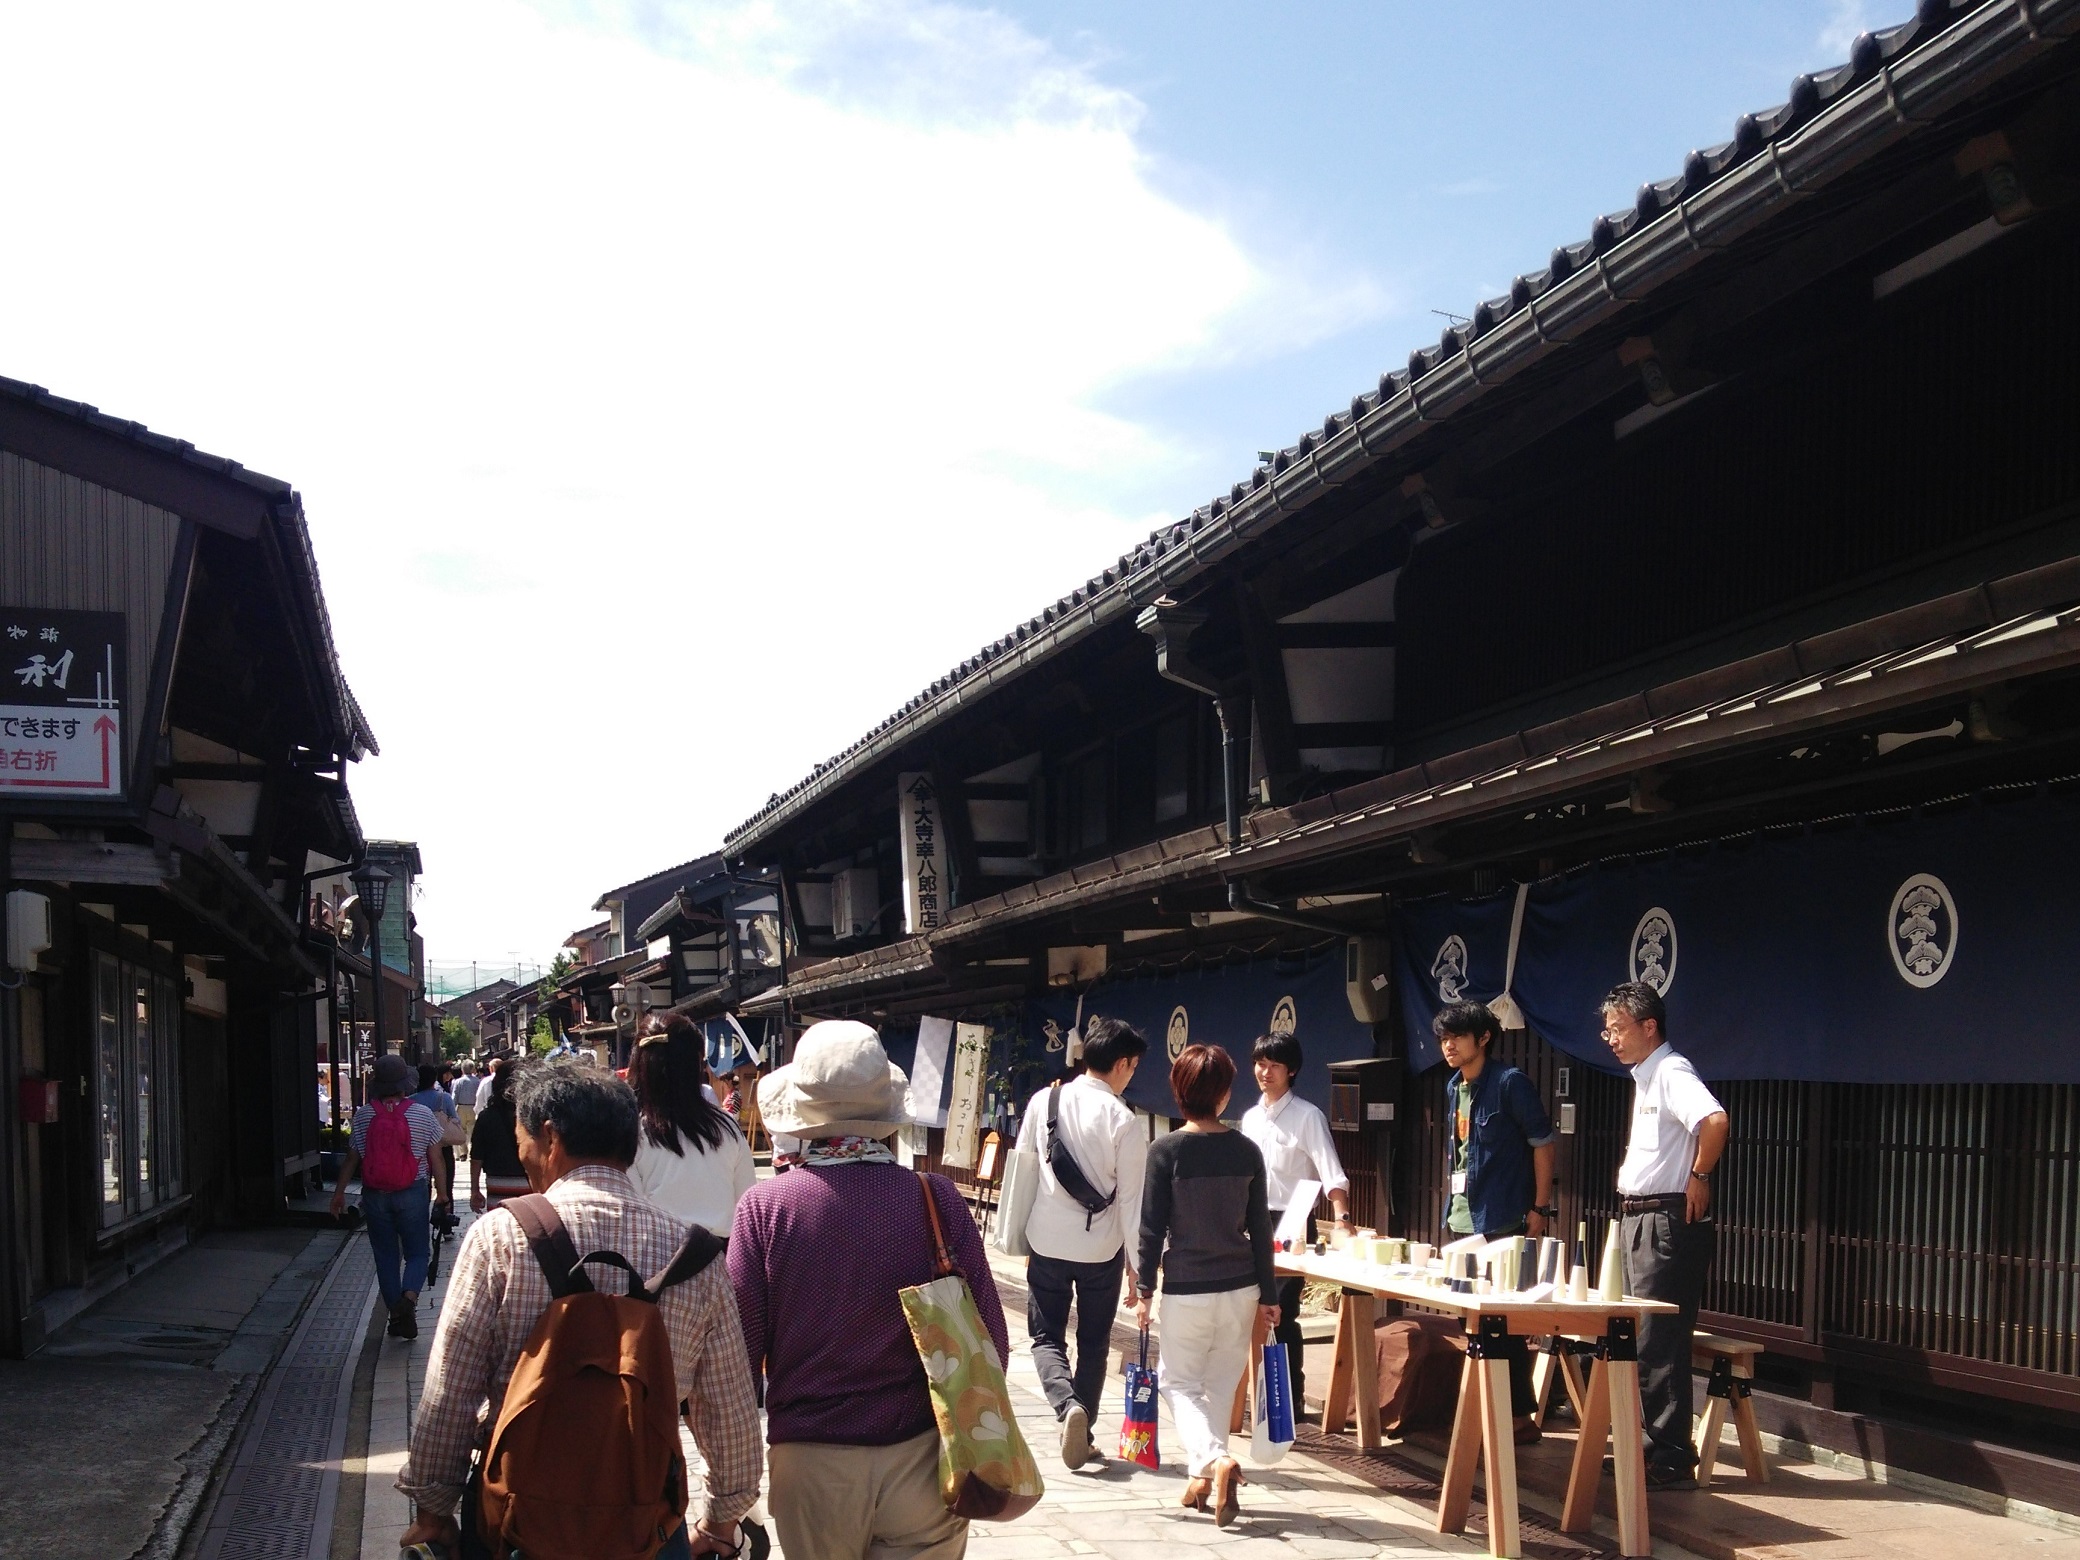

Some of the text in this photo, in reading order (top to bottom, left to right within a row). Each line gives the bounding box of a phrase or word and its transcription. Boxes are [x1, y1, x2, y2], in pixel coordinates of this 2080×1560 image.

[14, 649, 74, 690] 利
[0, 716, 81, 740] できます
[914, 806, 939, 929] 大寺幸八郎商店
